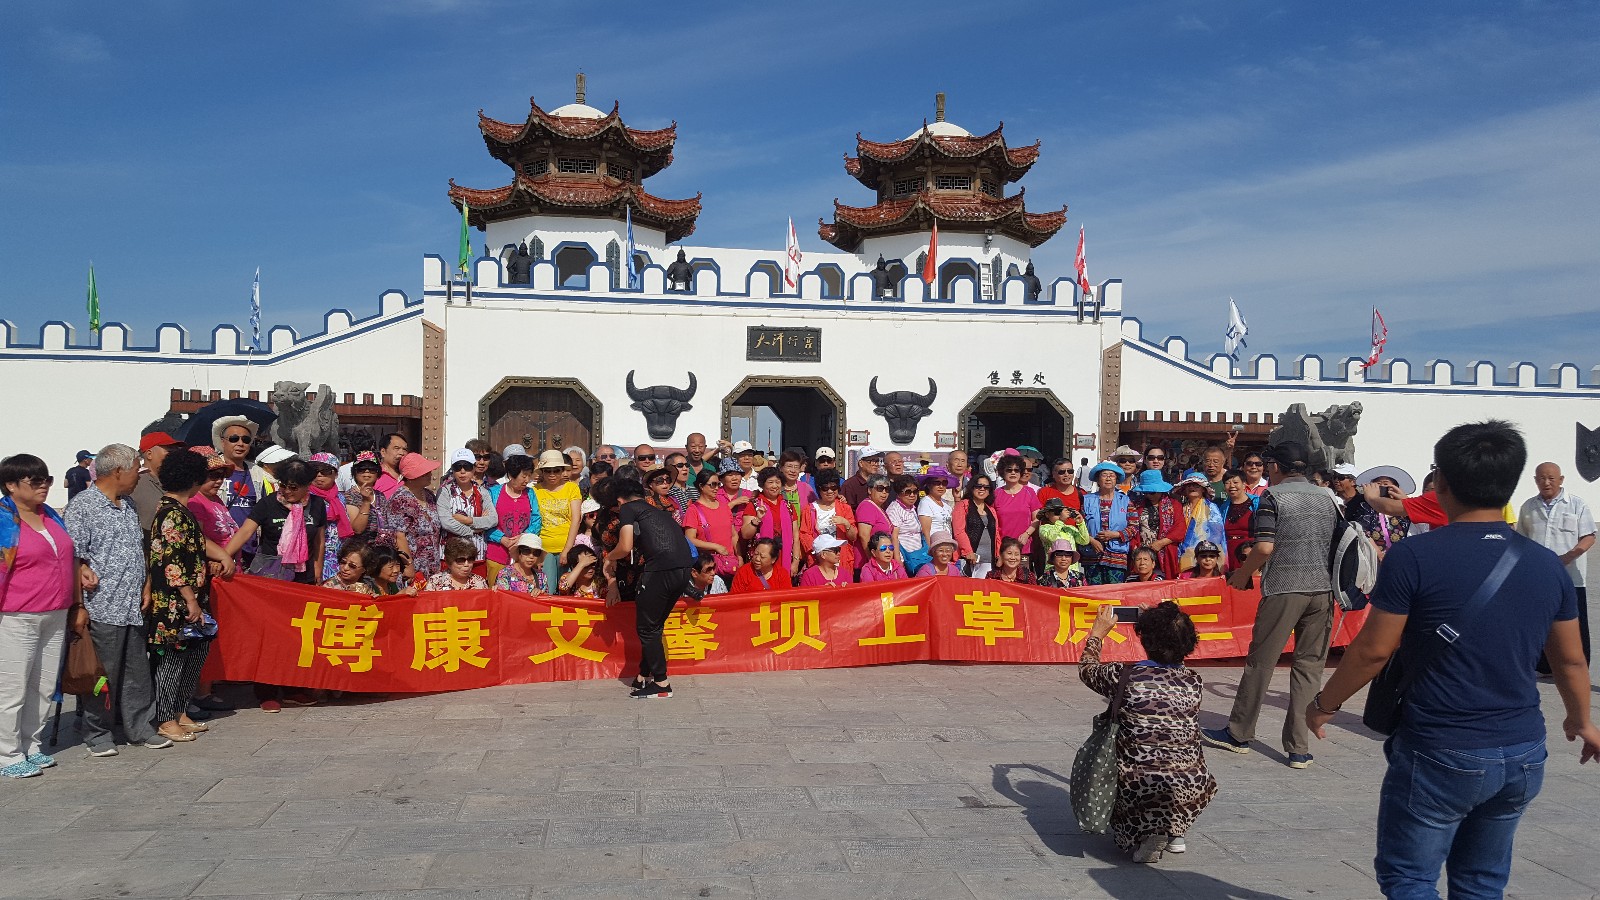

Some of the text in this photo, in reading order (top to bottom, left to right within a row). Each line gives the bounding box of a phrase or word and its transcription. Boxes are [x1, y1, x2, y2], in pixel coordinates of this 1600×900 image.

[987, 370, 1046, 385] 售票处
[290, 591, 1295, 672] 博康艾馨坝上草原三
